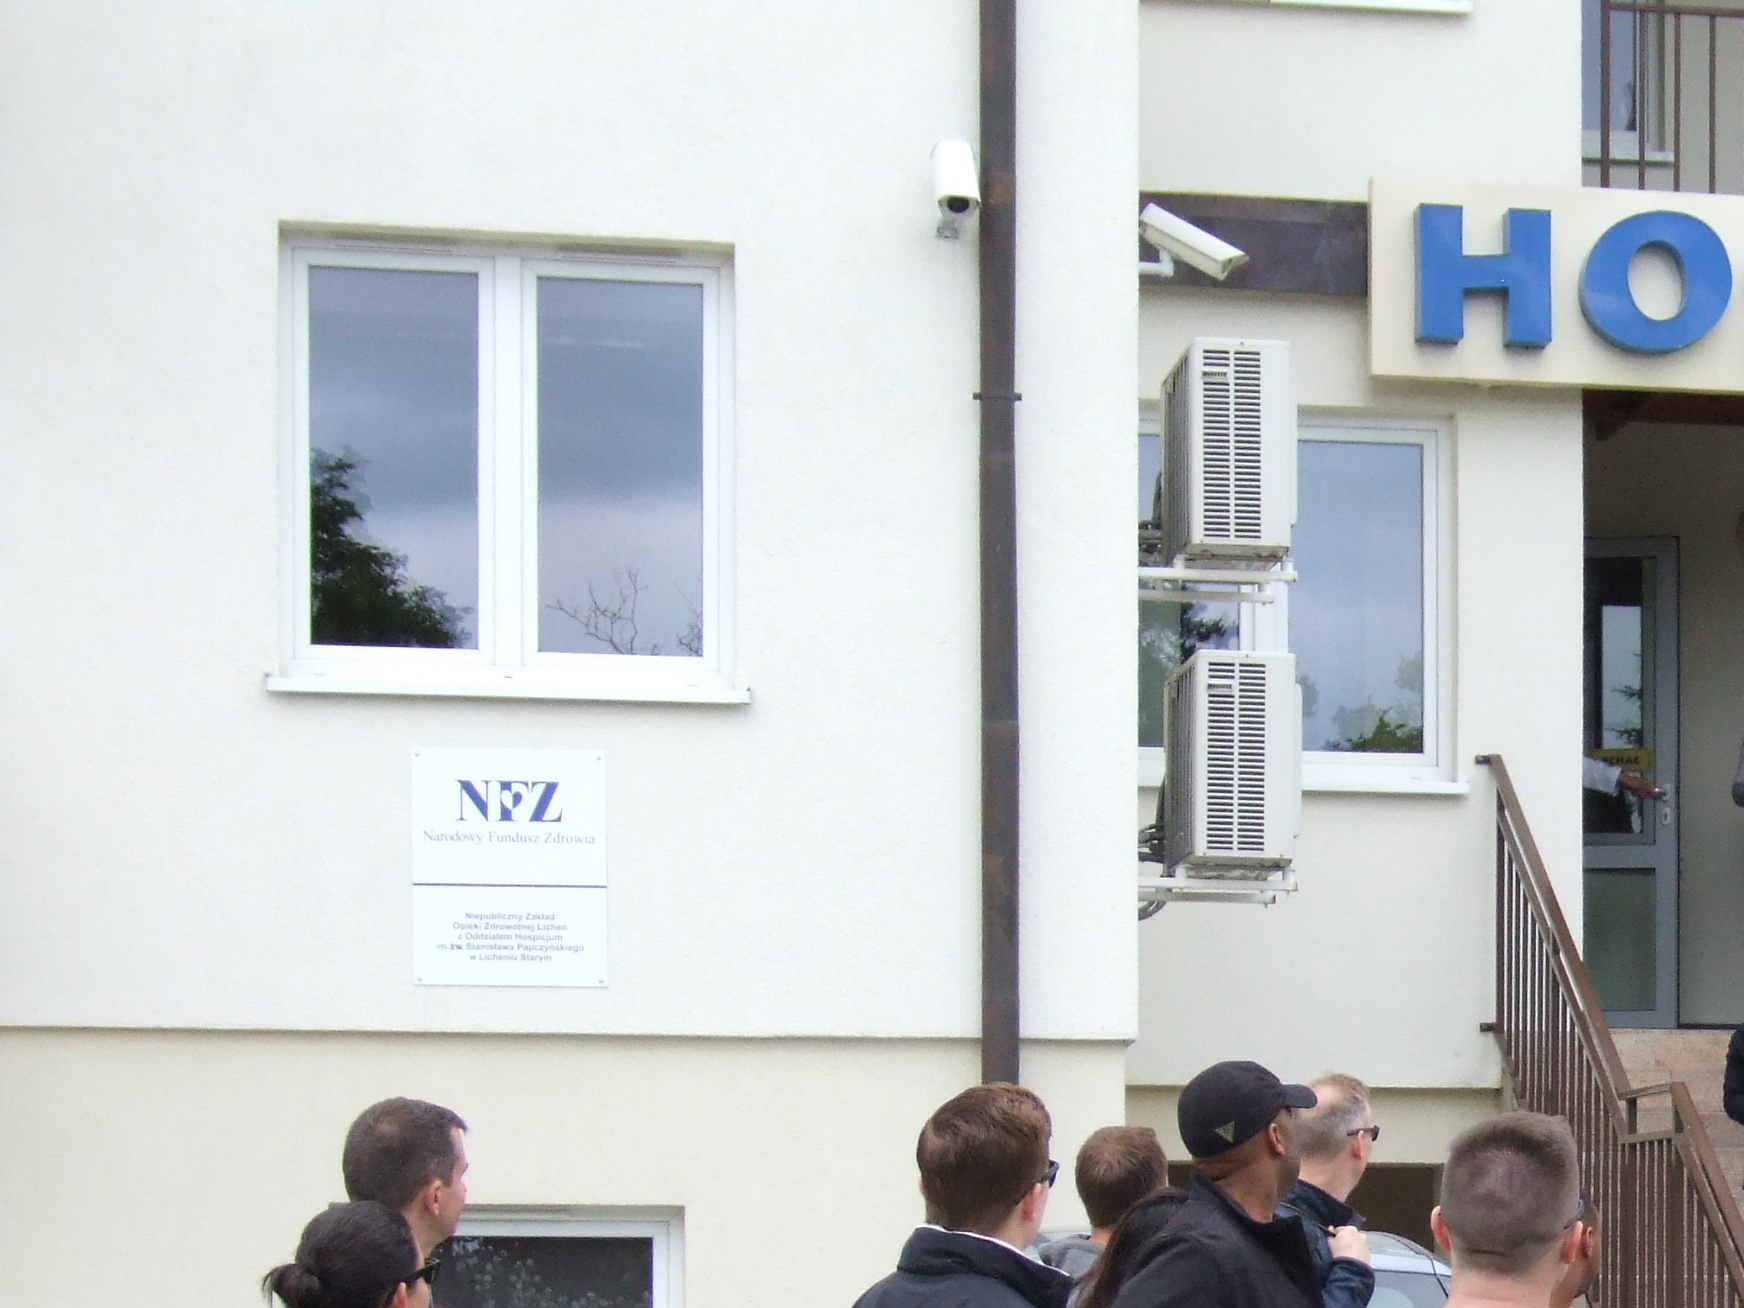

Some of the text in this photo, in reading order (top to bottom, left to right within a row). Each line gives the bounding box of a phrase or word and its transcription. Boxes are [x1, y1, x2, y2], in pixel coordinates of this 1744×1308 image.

[455, 779, 563, 823] NFZ
[423, 830, 595, 845] Narodowy Fundusz Zdrowia
[465, 912, 523, 921] Niepubliczny
[453, 922, 481, 930] Opieki
[484, 923, 535, 932] Zdrowotnej
[515, 934, 562, 942] Hospicjum
[521, 954, 551, 962] Starym
